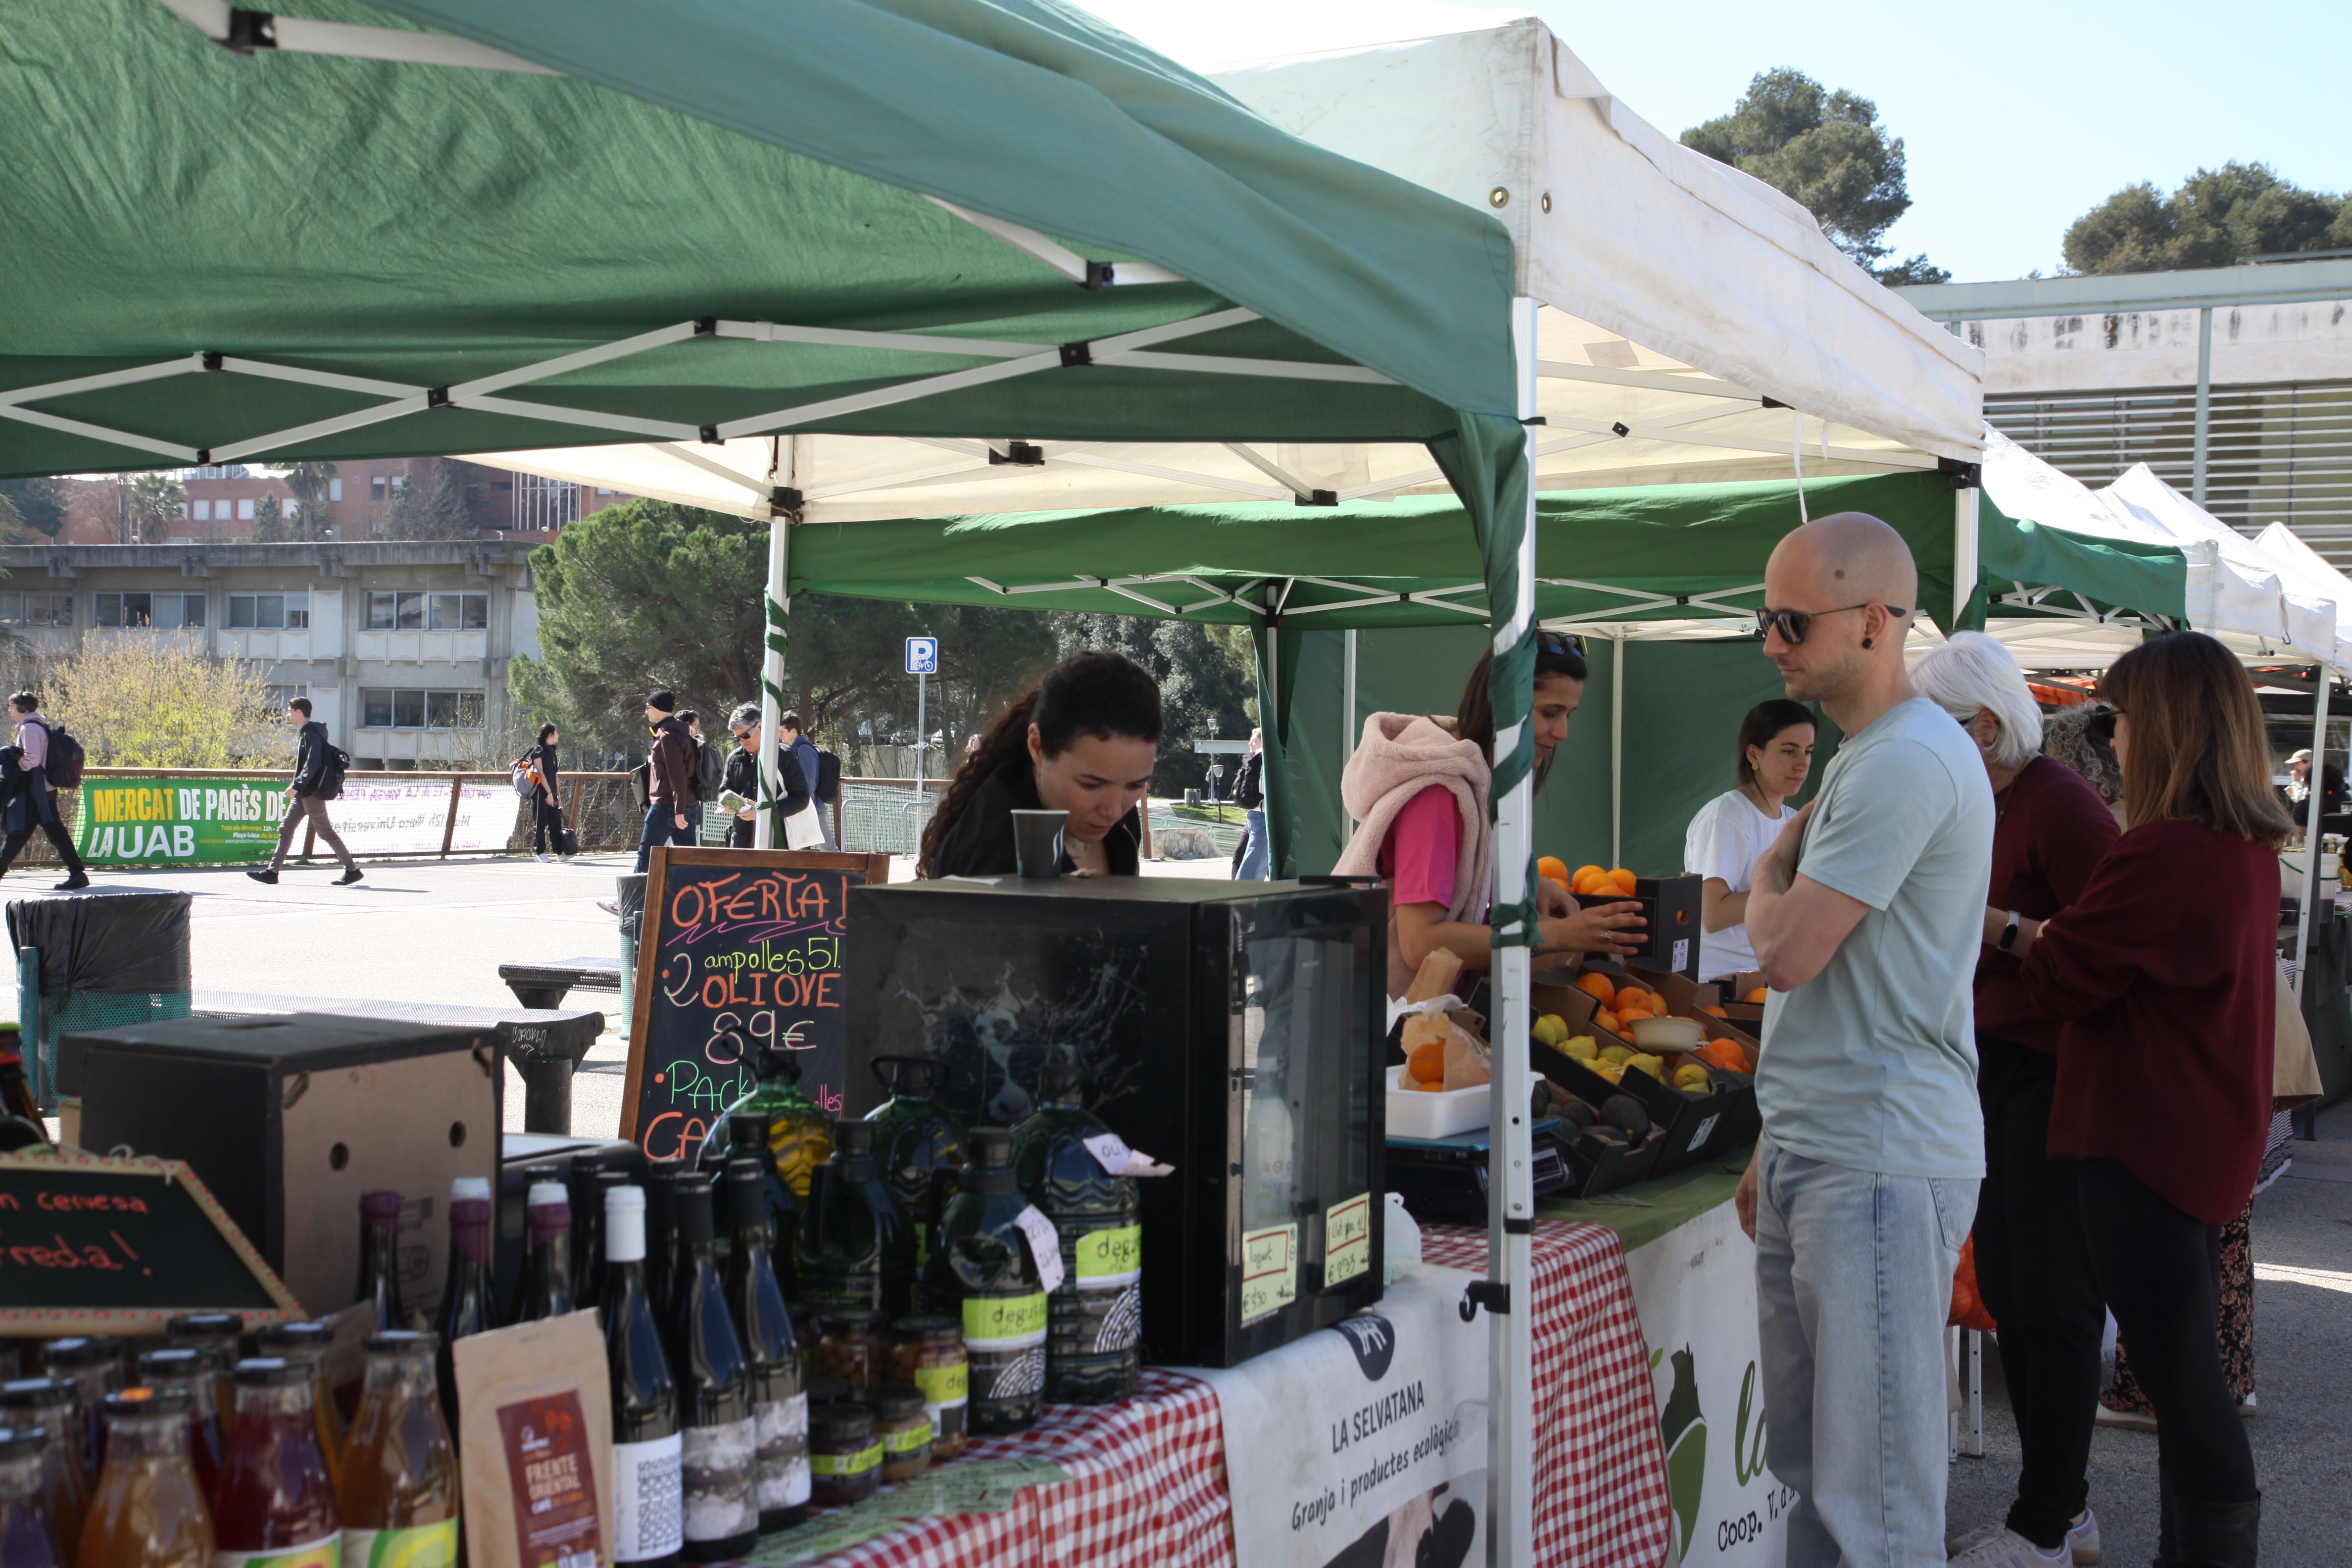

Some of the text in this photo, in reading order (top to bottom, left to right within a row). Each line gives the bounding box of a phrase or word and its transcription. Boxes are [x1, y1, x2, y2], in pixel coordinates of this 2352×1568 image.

[911, 640, 932, 670] P
[94, 788, 173, 822] MERCAT
[179, 788, 201, 820] DE
[205, 784, 261, 821] PAGÈS
[87, 826, 195, 858] LA UAB
[0, 1228, 152, 1277] reda!
[1332, 1379, 1424, 1454] LA SELVATANA
[1292, 1486, 1335, 1532] Granja
[1341, 1478, 1345, 1505] i
[1351, 1457, 1409, 1509] productes
[1718, 1511, 1763, 1552] Coop.
